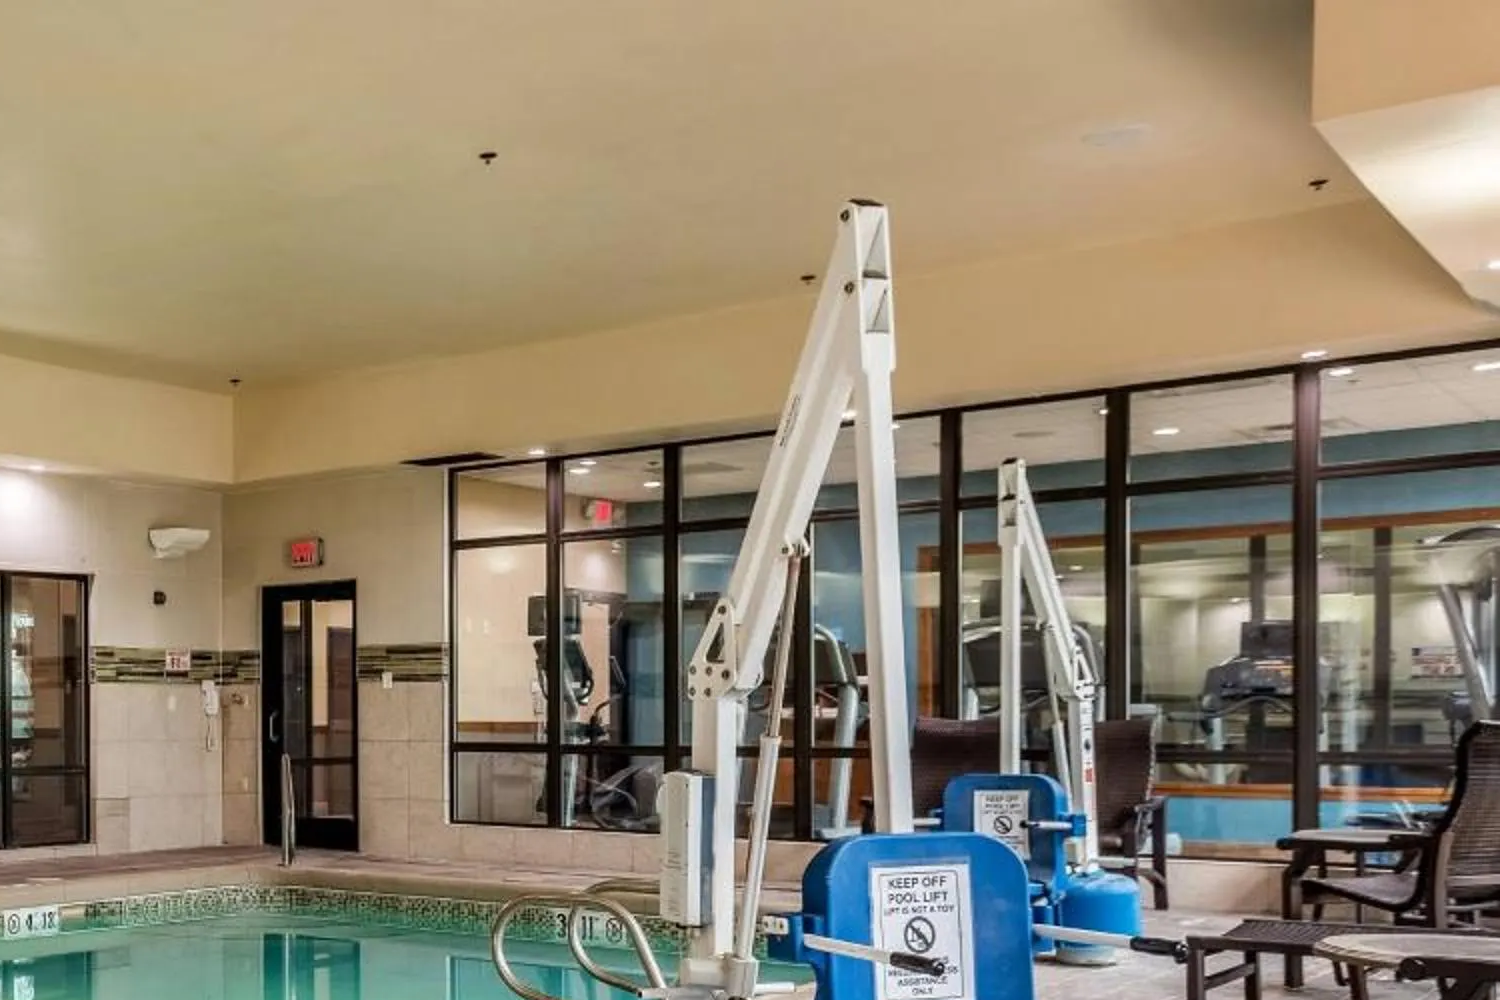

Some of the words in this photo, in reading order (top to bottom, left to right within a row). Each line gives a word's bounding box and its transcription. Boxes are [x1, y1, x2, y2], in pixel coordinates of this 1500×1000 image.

[888, 877, 918, 889] KEEP
[921, 876, 947, 888] OFF
[888, 892, 920, 904] POOL
[923, 891, 948, 903] LIFT
